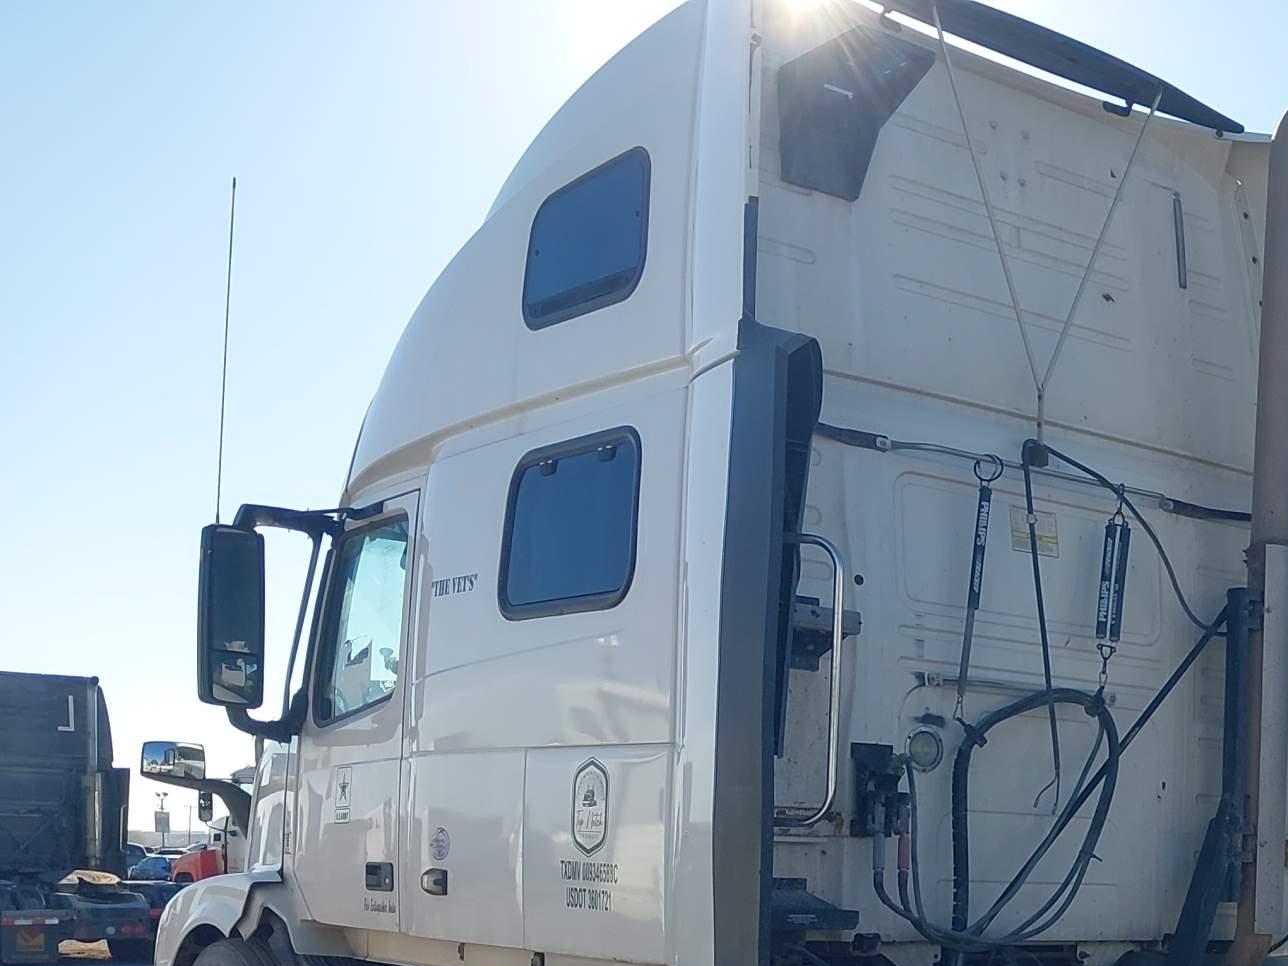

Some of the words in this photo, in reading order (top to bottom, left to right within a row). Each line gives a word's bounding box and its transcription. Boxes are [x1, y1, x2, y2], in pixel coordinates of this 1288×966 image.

[976, 501, 989, 546] PHILLIPS
[1099, 581, 1110, 622] PHILLIPS
[566, 887, 587, 909] USDOT
